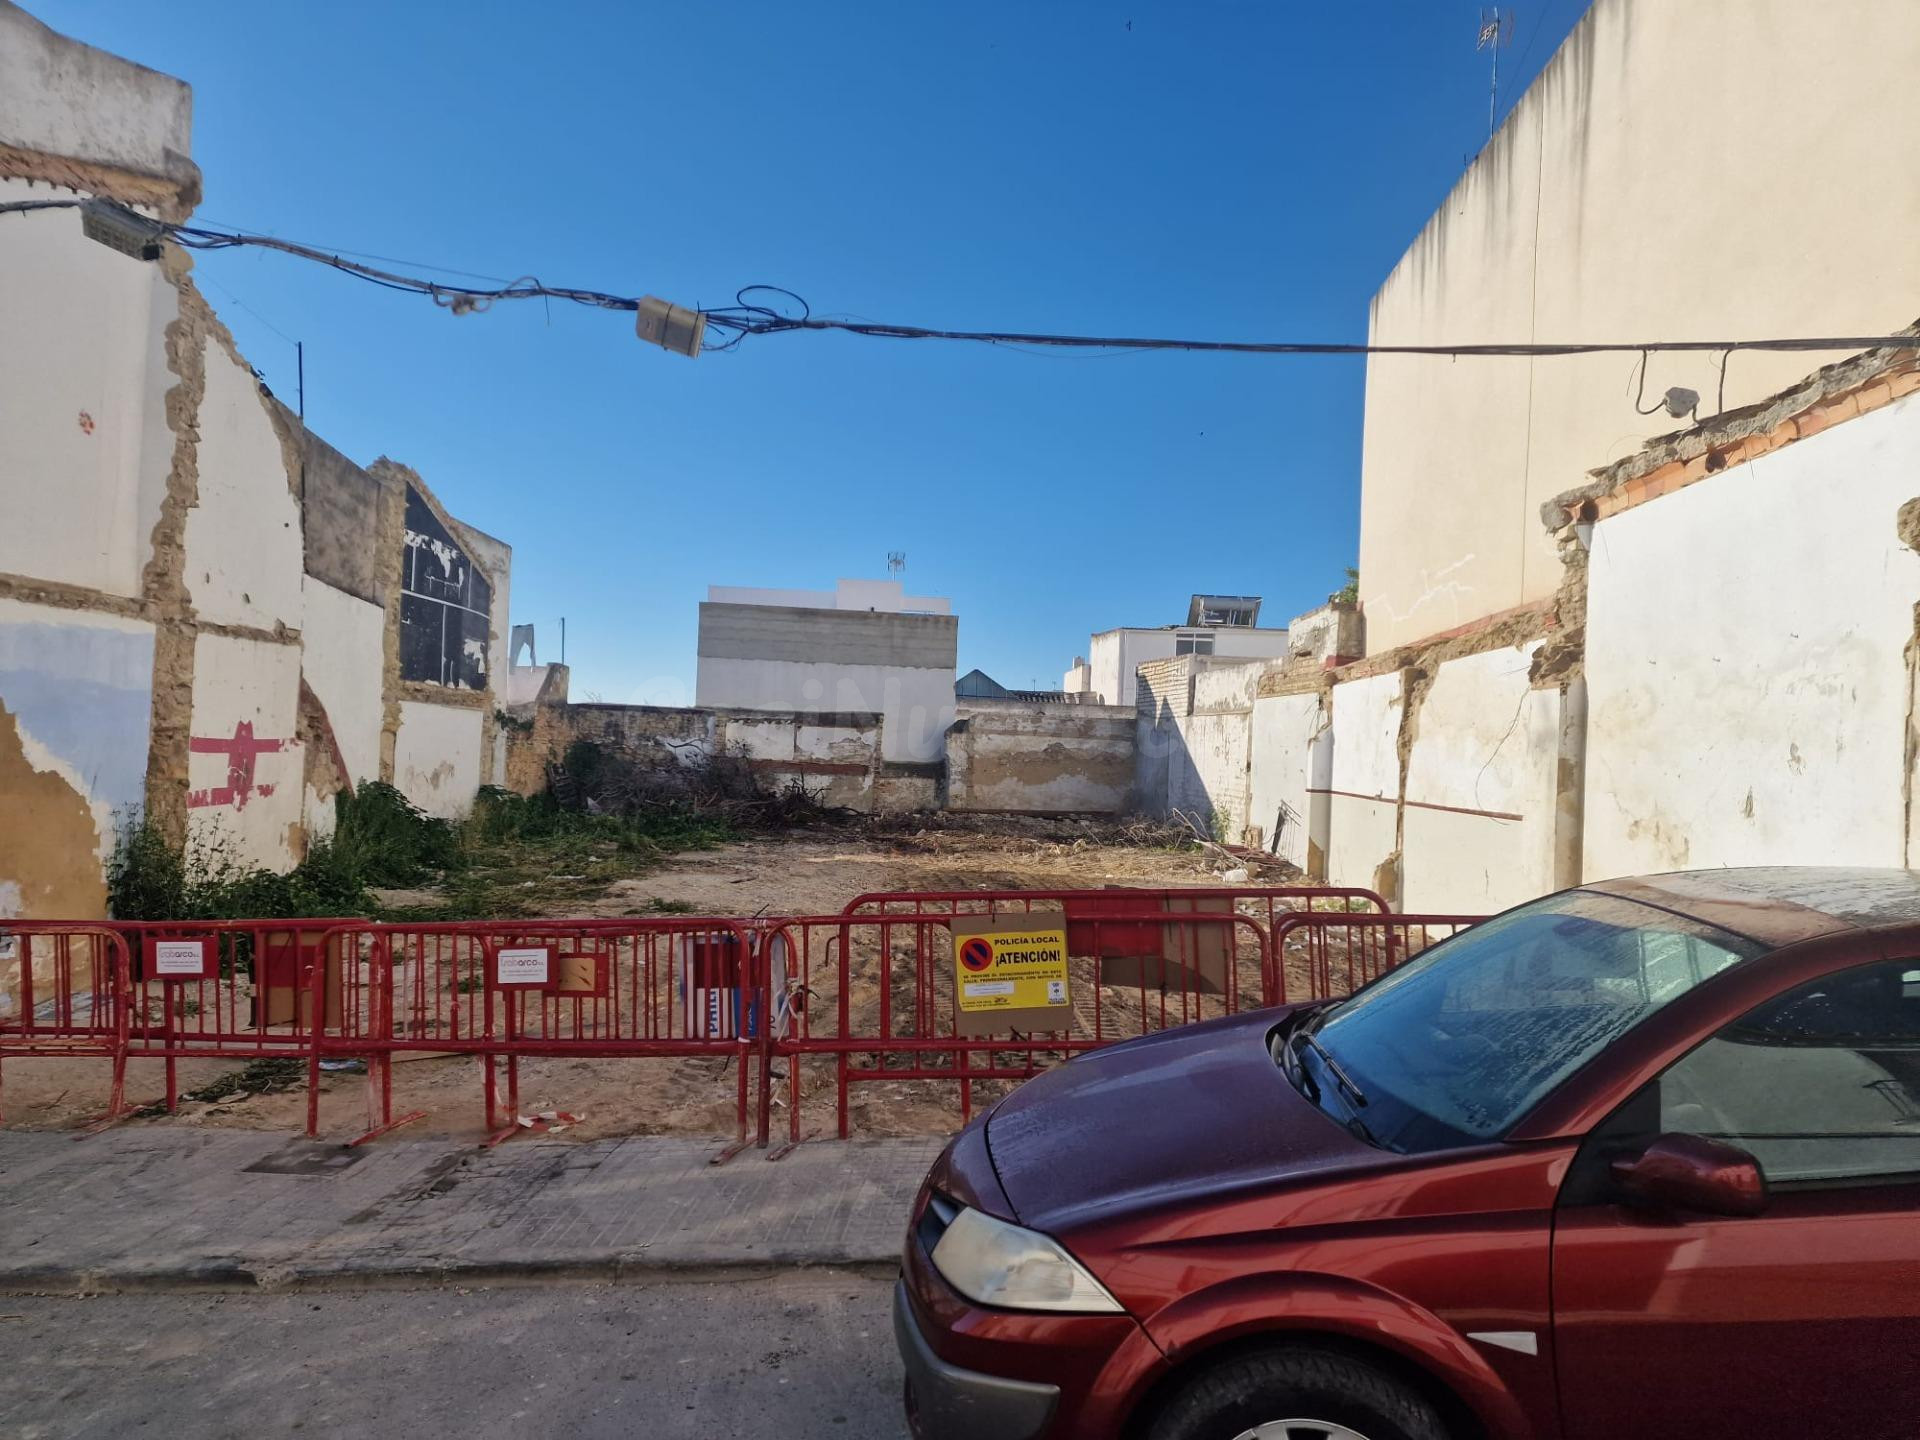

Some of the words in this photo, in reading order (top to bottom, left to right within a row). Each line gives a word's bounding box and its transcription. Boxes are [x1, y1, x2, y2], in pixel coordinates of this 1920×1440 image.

[994, 936, 1028, 946] POLICÍA
[1031, 936, 1060, 944] LOCAL
[995, 947, 1061, 967] ¡ATENCIÓN!
[708, 991, 718, 1033] PHILI
